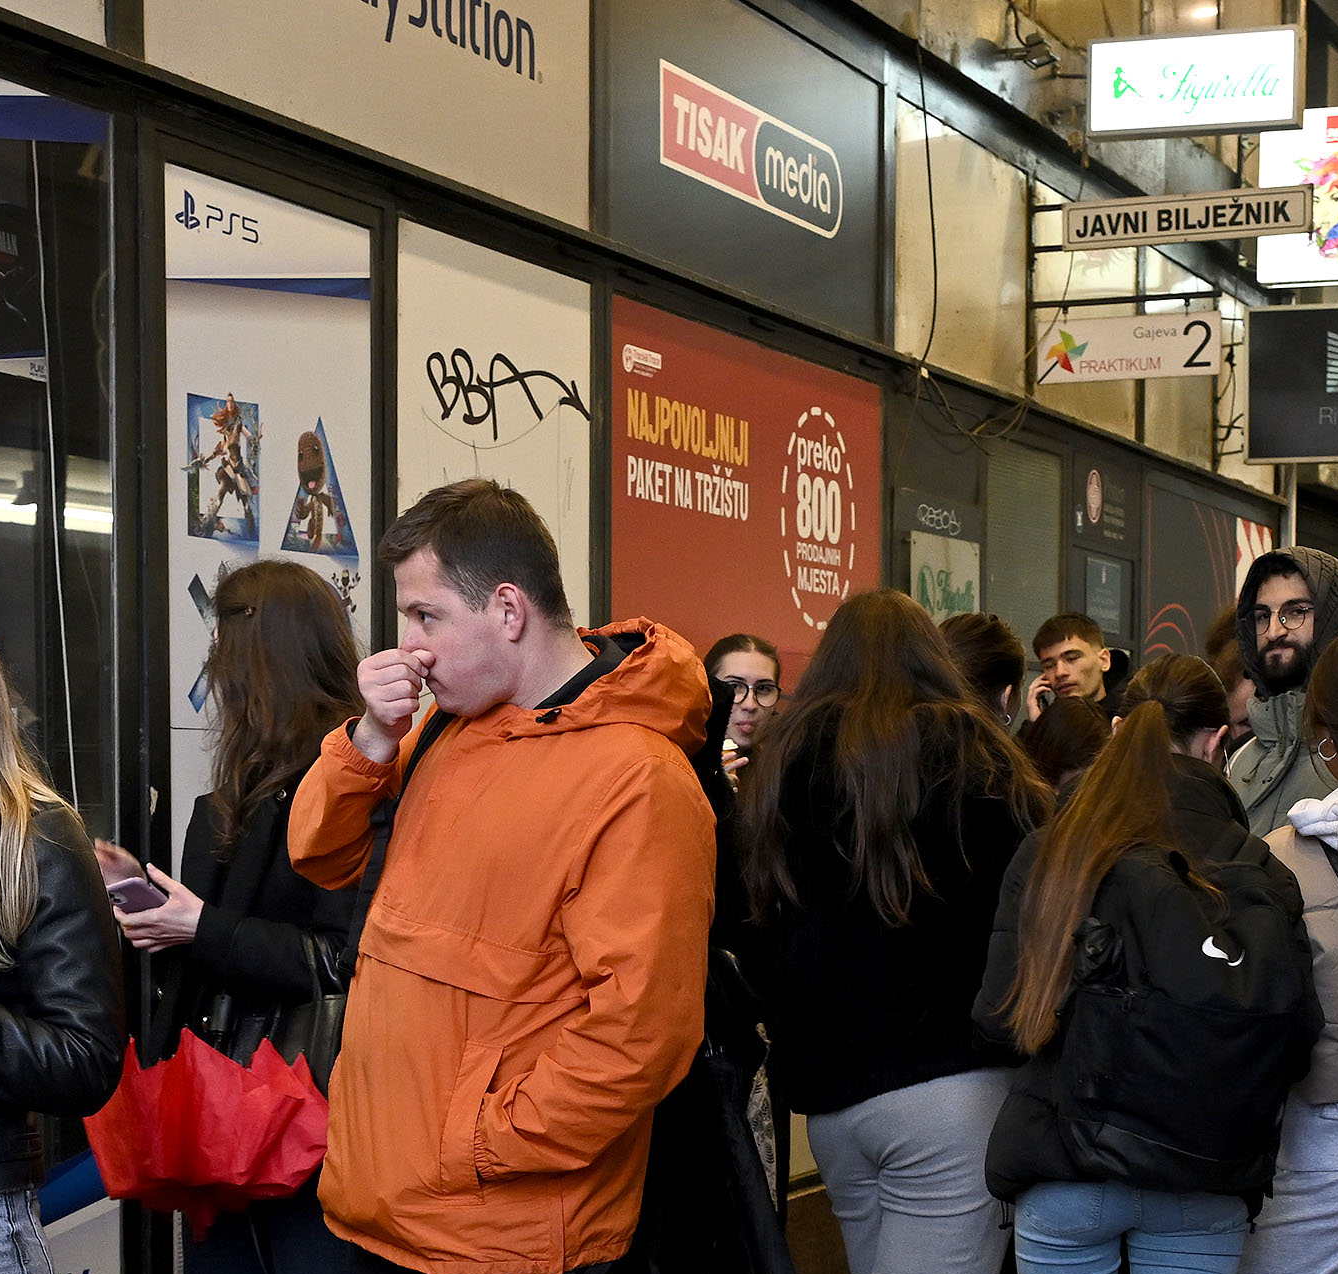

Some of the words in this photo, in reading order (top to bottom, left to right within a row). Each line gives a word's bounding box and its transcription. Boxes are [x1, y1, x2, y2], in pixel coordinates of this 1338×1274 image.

[673, 93, 747, 175] TISAK
[765, 146, 831, 214] media
[206, 204, 259, 244] PS5
[1076, 211, 1148, 239] JAVNI
[1157, 195, 1291, 232] BILJEŽNIK
[1079, 356, 1161, 375] PRAKTIKUM
[1133, 326, 1177, 341] Gajeva
[1182, 320, 1212, 368] 2
[626, 388, 749, 468] NAJPOVOLJNIJI
[796, 434, 841, 474] preko
[626, 455, 673, 505] PAKET
[674, 466, 693, 510] NA
[695, 463, 749, 522] TRŽIŠTU
[796, 472, 841, 545] 800
[796, 542, 841, 567] PRODAJNIH
[797, 566, 840, 596] MJESTA
